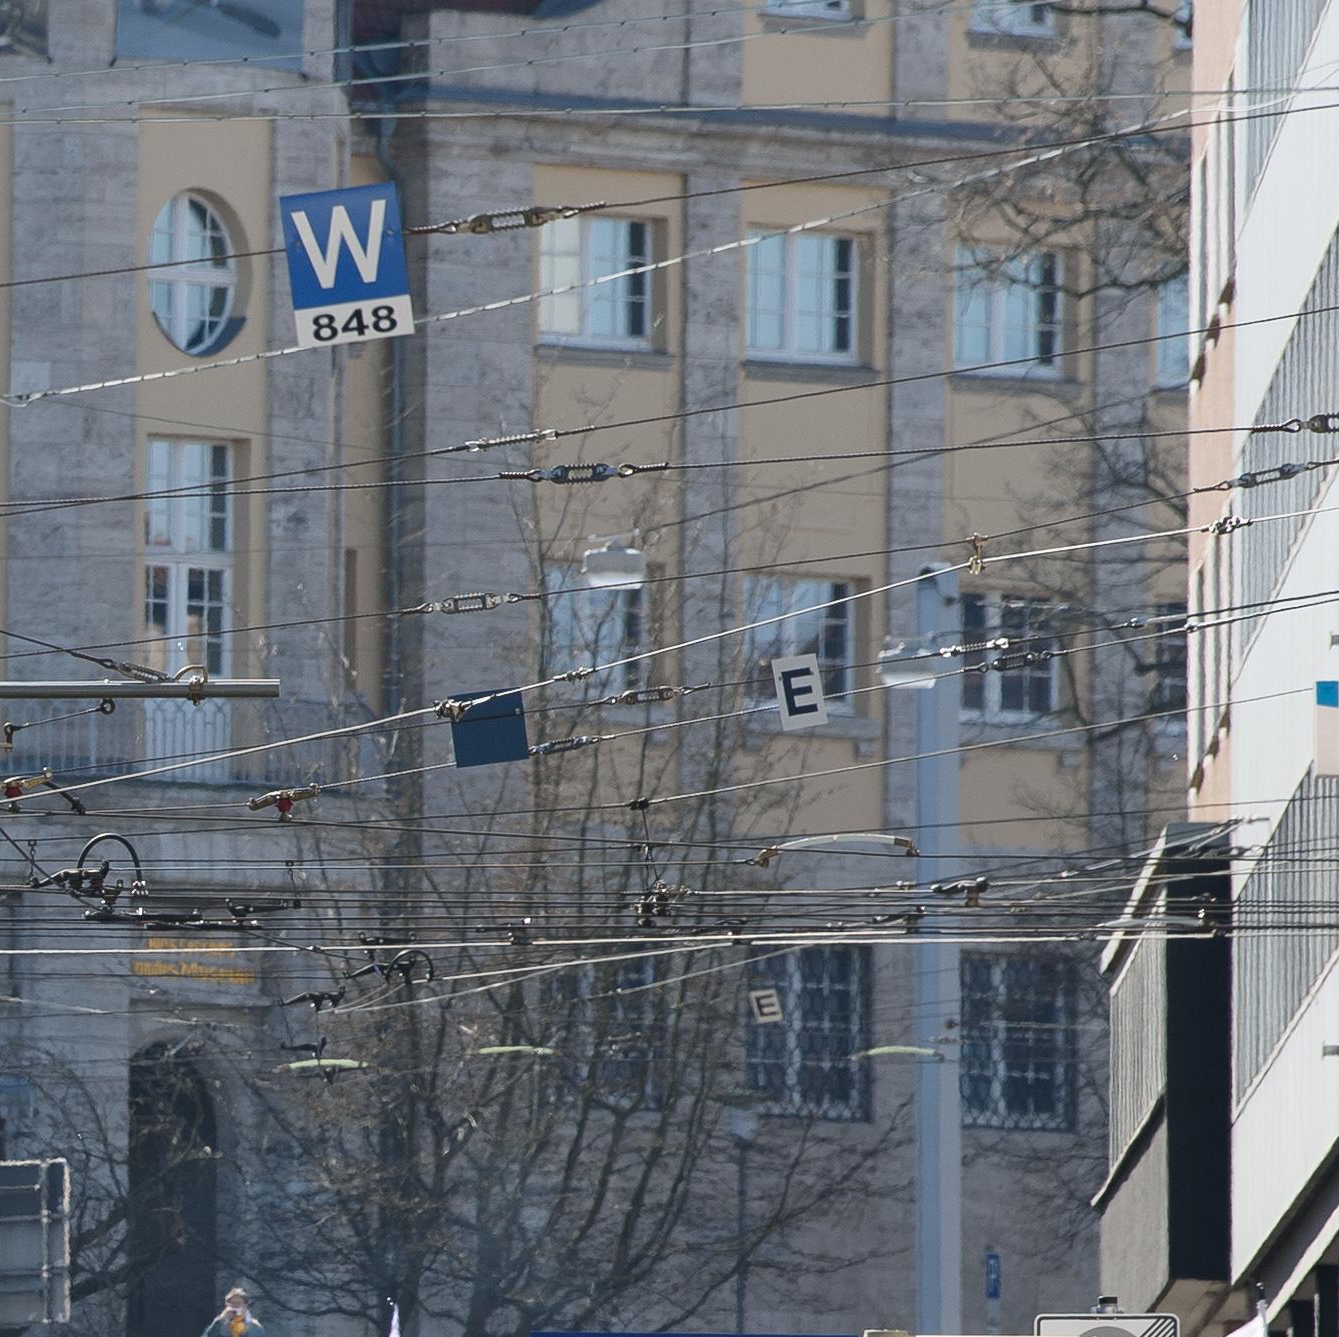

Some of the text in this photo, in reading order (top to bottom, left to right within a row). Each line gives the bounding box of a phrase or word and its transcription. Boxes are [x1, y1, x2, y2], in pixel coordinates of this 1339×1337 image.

[291, 200, 386, 289] W
[313, 305, 397, 342] 848
[782, 669, 820, 717] E
[756, 996, 777, 1017] E
